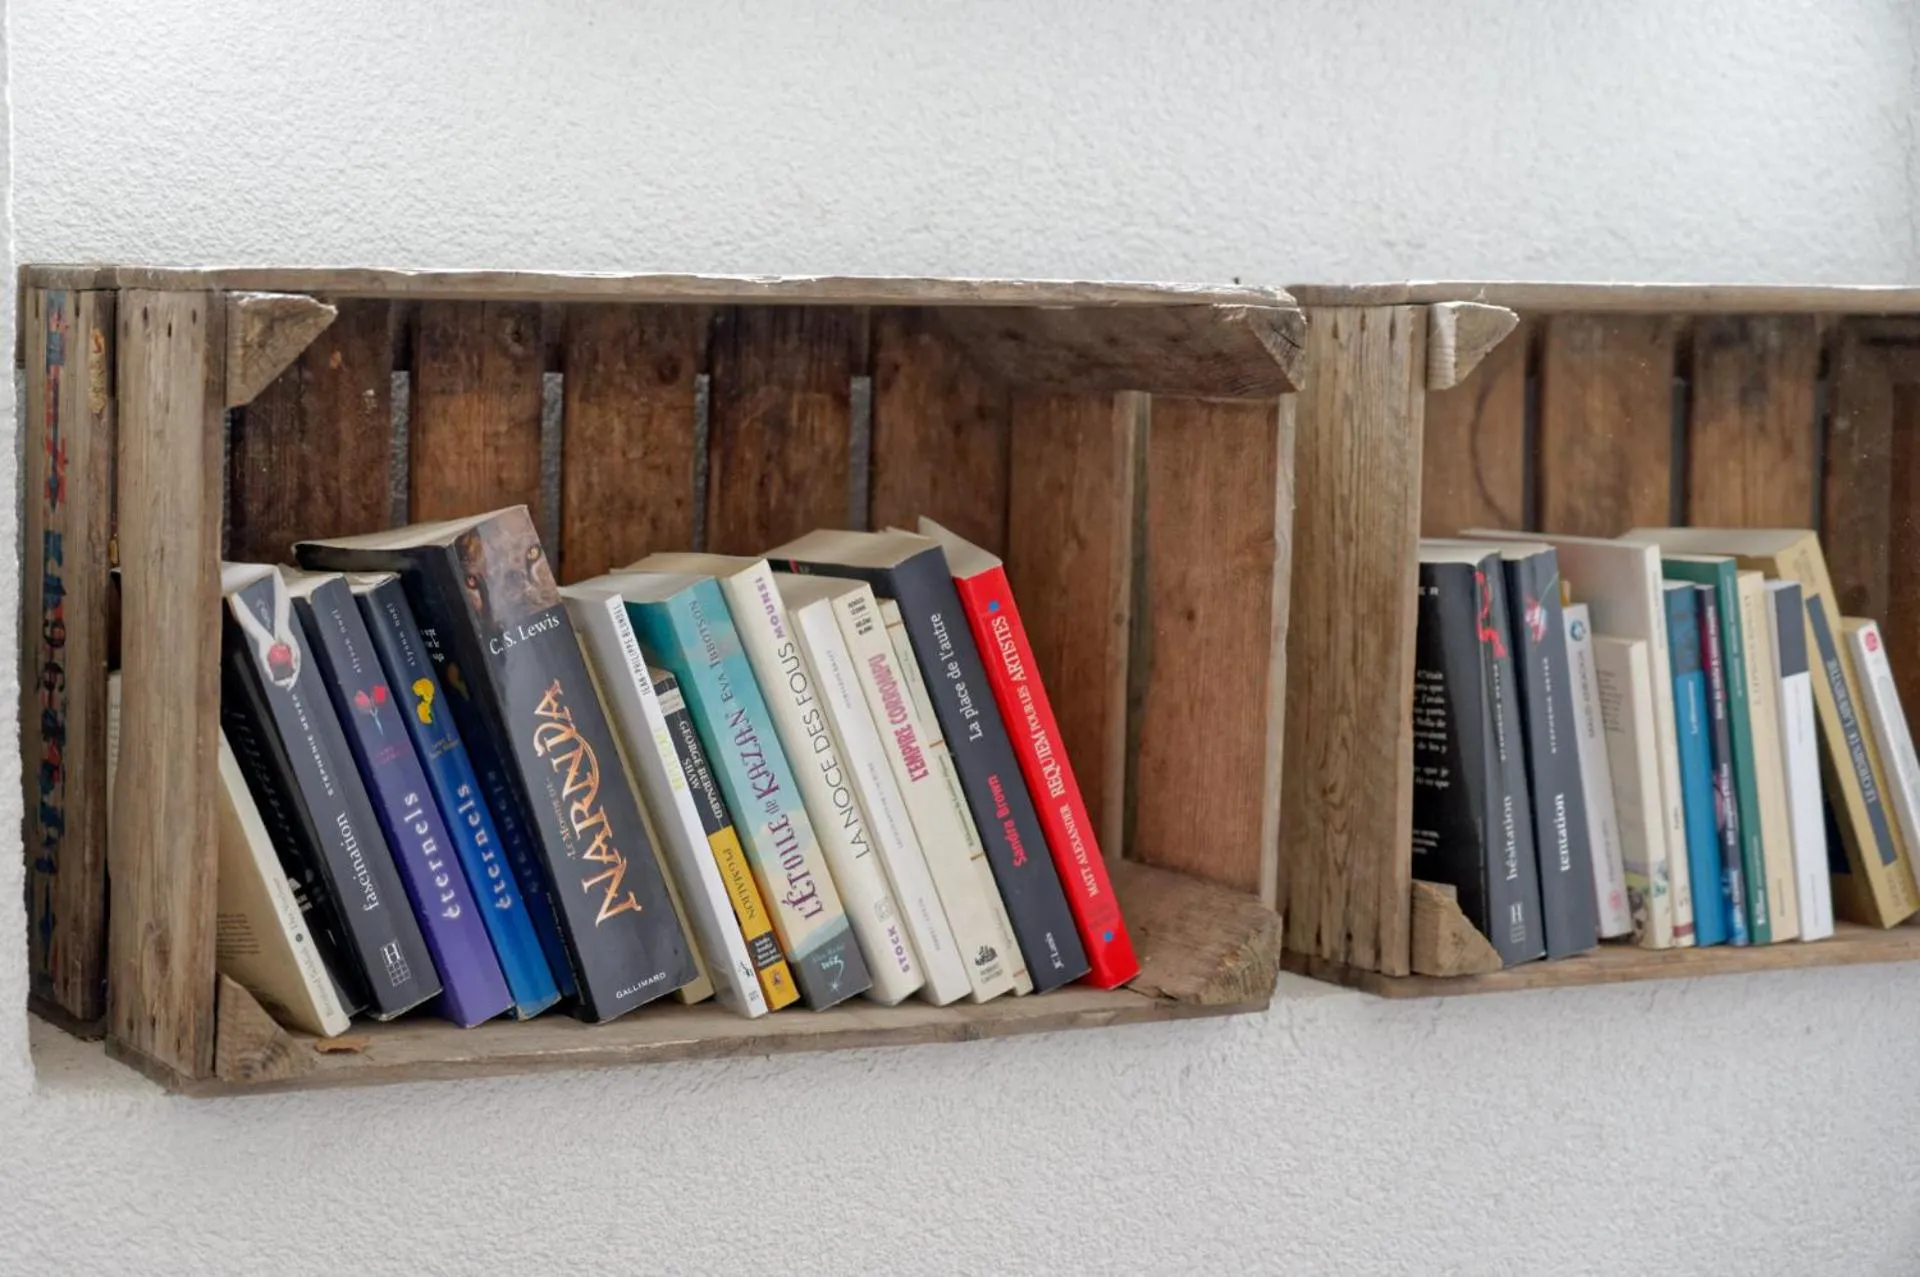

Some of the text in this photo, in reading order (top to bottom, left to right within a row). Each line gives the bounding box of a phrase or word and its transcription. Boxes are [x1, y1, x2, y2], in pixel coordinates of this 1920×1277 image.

[518, 613, 560, 638] Lewis
[754, 576, 786, 639] MOUNSI
[689, 599, 734, 703] EVA IBBOTSON
[868, 652, 908, 725] CORROMPU
[930, 613, 983, 742] La place de l'autre
[992, 616, 1027, 682] ARTISTES
[292, 693, 334, 797] STEPHENIE MEYER
[728, 707, 780, 800] KAZAN
[777, 642, 871, 859] LA NOCE DES FOUS
[893, 723, 930, 783] L'EMPIRE
[1023, 704, 1041, 734] POUR
[533, 679, 642, 927] NARNIA
[679, 720, 723, 821] GEORGE BERNARD
[682, 758, 701, 790] SHAW
[1034, 733, 1065, 798] REQUIEM
[457, 783, 512, 909] éternels
[764, 799, 780, 815] de
[987, 773, 1028, 867] Sandra Brown
[1504, 795, 1518, 881] hésitation
[1554, 793, 1571, 872] tentation
[336, 813, 379, 911] fascination
[403, 792, 461, 919] éternels
[723, 848, 756, 921] PYGMALION
[1060, 804, 1099, 897] MATT ALEXANDER
[616, 972, 667, 999] GALLIMARD
[887, 925, 911, 974] STOCK
